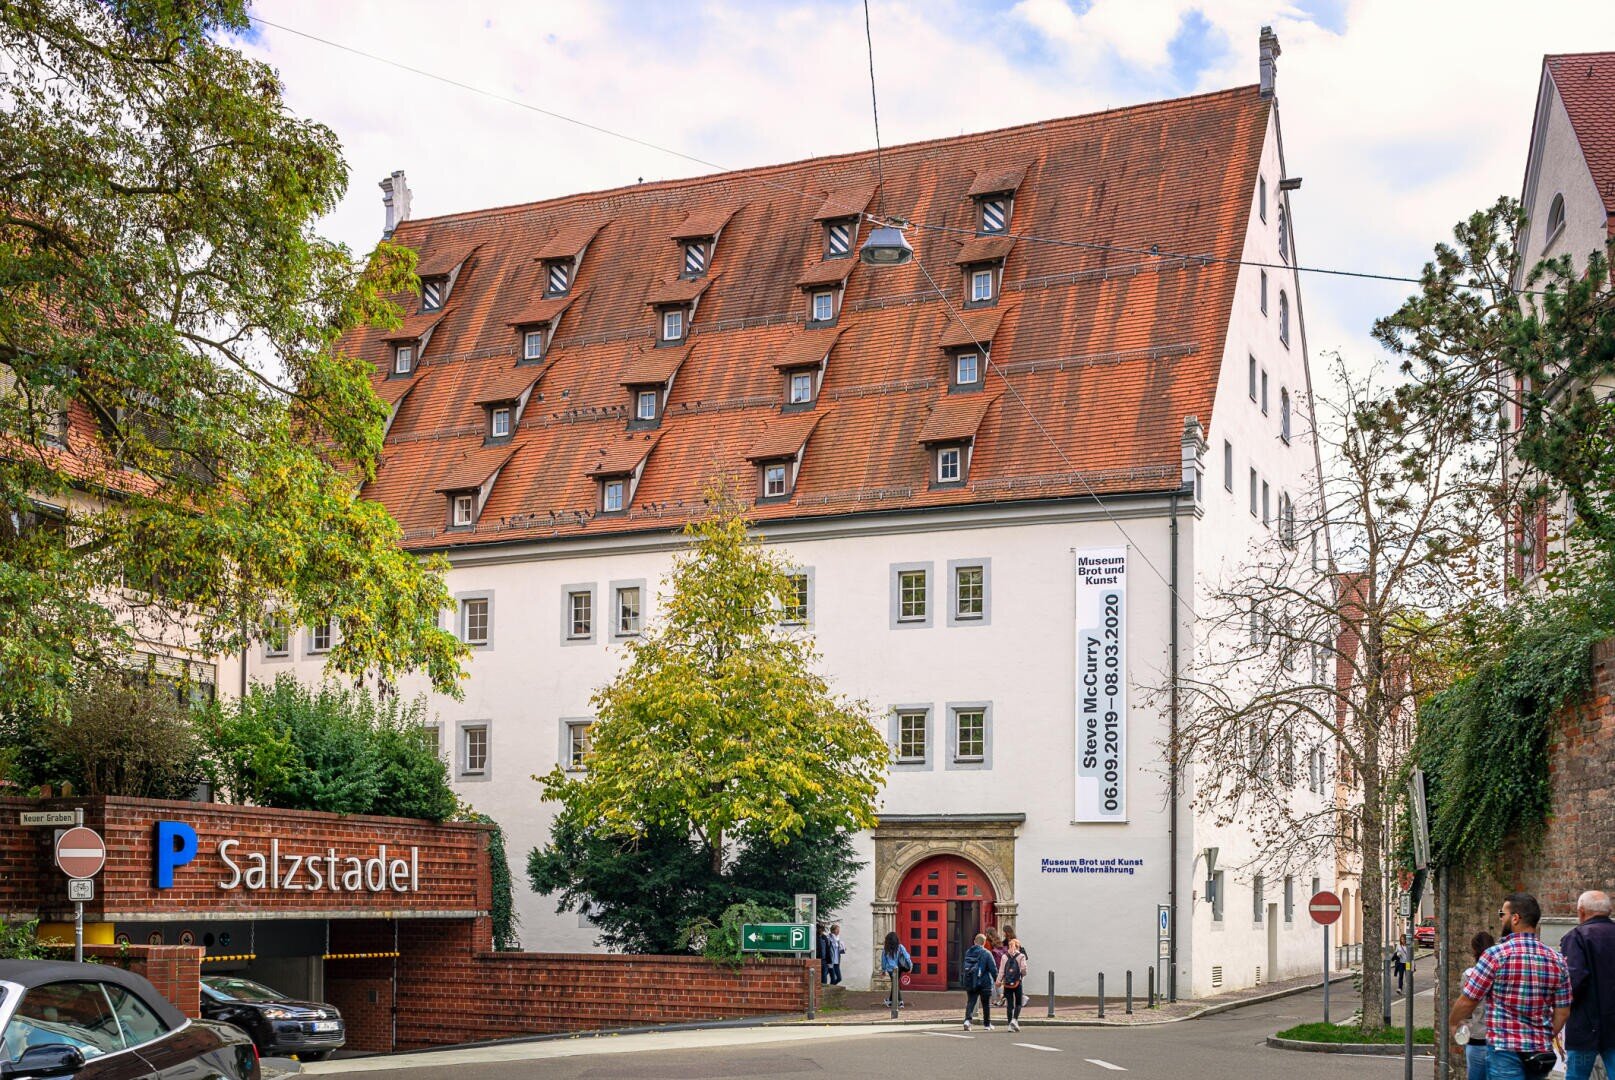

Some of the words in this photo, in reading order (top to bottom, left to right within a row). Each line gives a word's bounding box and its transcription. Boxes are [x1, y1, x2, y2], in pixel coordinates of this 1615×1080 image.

[1078, 557, 1125, 566] Museum
[1078, 567, 1102, 575] Brot
[1104, 565, 1125, 574] und
[1085, 576, 1118, 585] Kunst
[1083, 636, 1101, 713] McCurry
[1083, 718, 1098, 768] Steve
[23, 814, 44, 823] Neuer
[46, 813, 72, 822] Graben
[153, 820, 198, 889] P
[217, 838, 419, 893] Salzstadel
[1071, 866, 1134, 874] Welternährung
